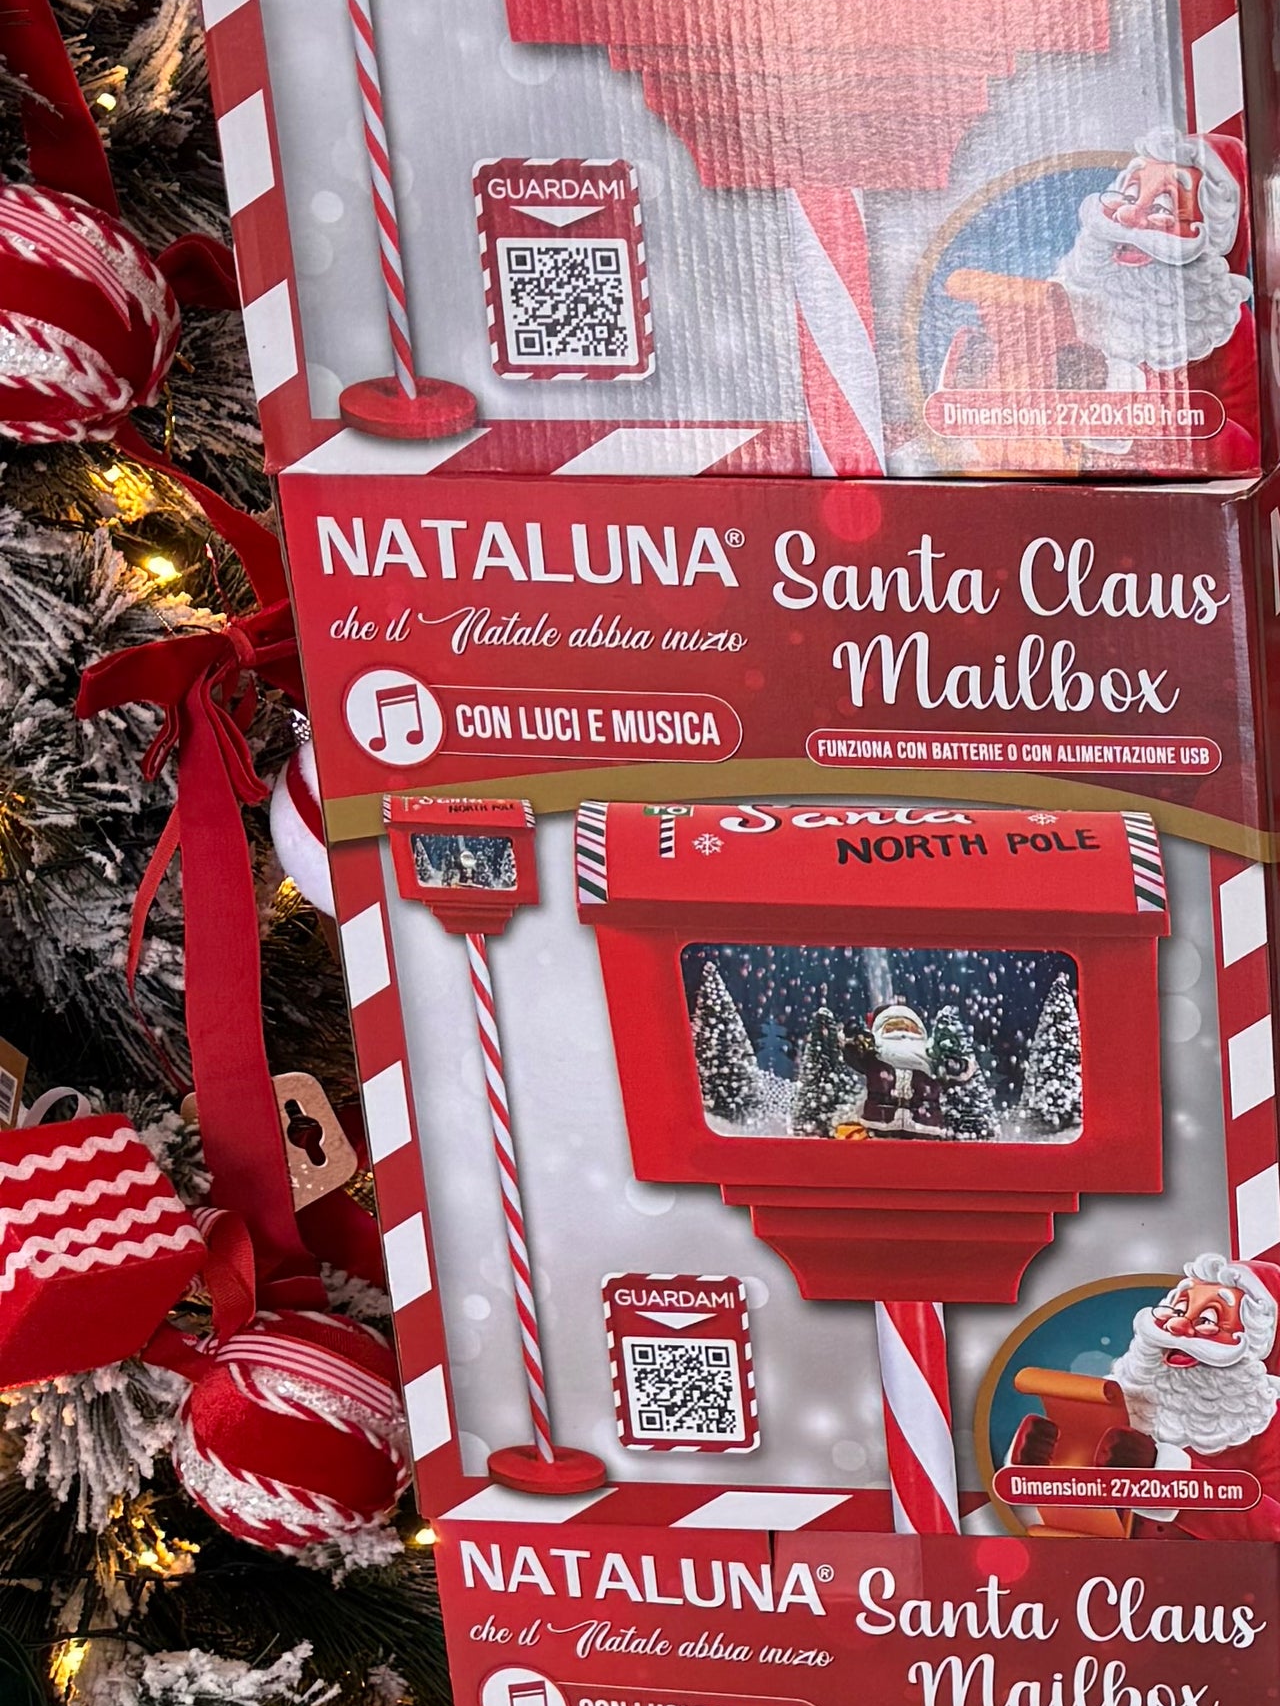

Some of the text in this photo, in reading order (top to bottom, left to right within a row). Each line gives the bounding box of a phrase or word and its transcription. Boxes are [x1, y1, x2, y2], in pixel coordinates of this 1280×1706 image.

[487, 177, 626, 201] GUARDAMI
[943, 402, 1205, 427] Dimensioni: 27x20x150 h cm
[772, 529, 1000, 615] Santa
[1018, 536, 1231, 625] Claus
[329, 606, 749, 655] che il Natale abbia inizio
[832, 631, 1180, 714] Mailbox
[455, 703, 722, 746] CON LUCI E MUSICA
[817, 739, 1211, 766] FUNZIONA CON BATTERIE O CON ALIMENTAZIONE USB
[836, 828, 1101, 865] NORTH POLE
[613, 1287, 737, 1311] GUARDAMI
[1010, 1475, 1244, 1502] Dimensioni: 27x20x150 h cm
[854, 1566, 1268, 1650] Santa Claus
[468, 1614, 836, 1669] che il Natale abbia inizio
